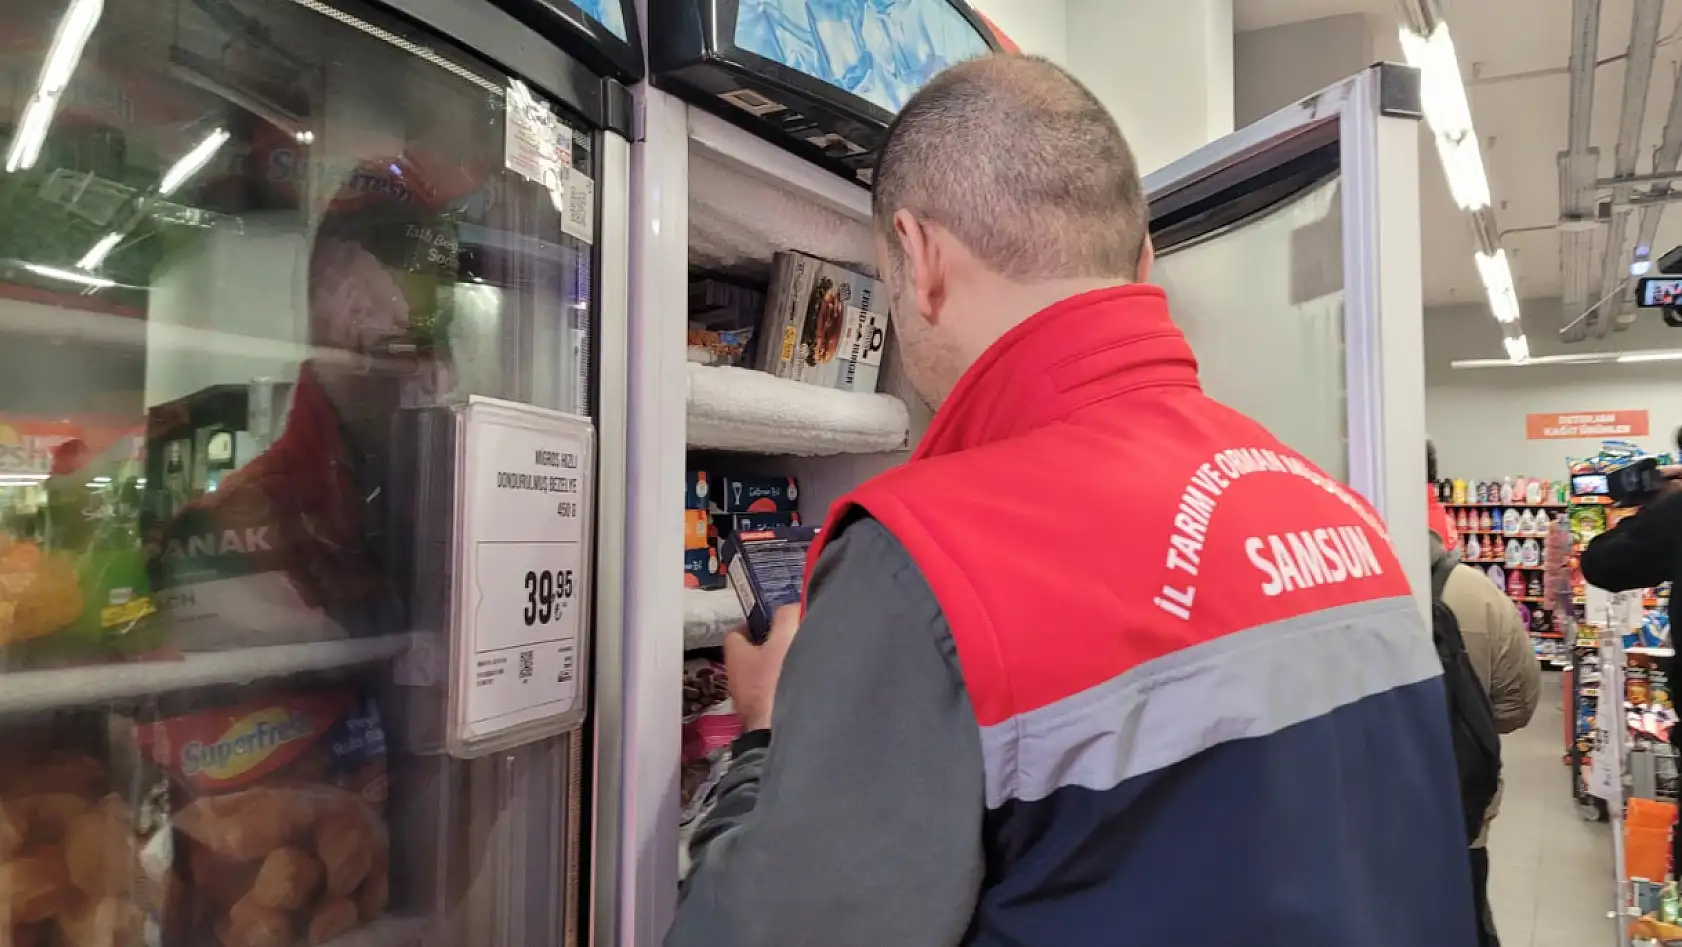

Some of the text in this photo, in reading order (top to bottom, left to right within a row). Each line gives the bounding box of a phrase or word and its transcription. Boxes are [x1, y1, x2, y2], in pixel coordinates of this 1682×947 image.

[159, 526, 274, 561] ANAK
[1153, 447, 1288, 621] İL TARIM VE ORMAN
[1244, 525, 1384, 596] SAMSUN
